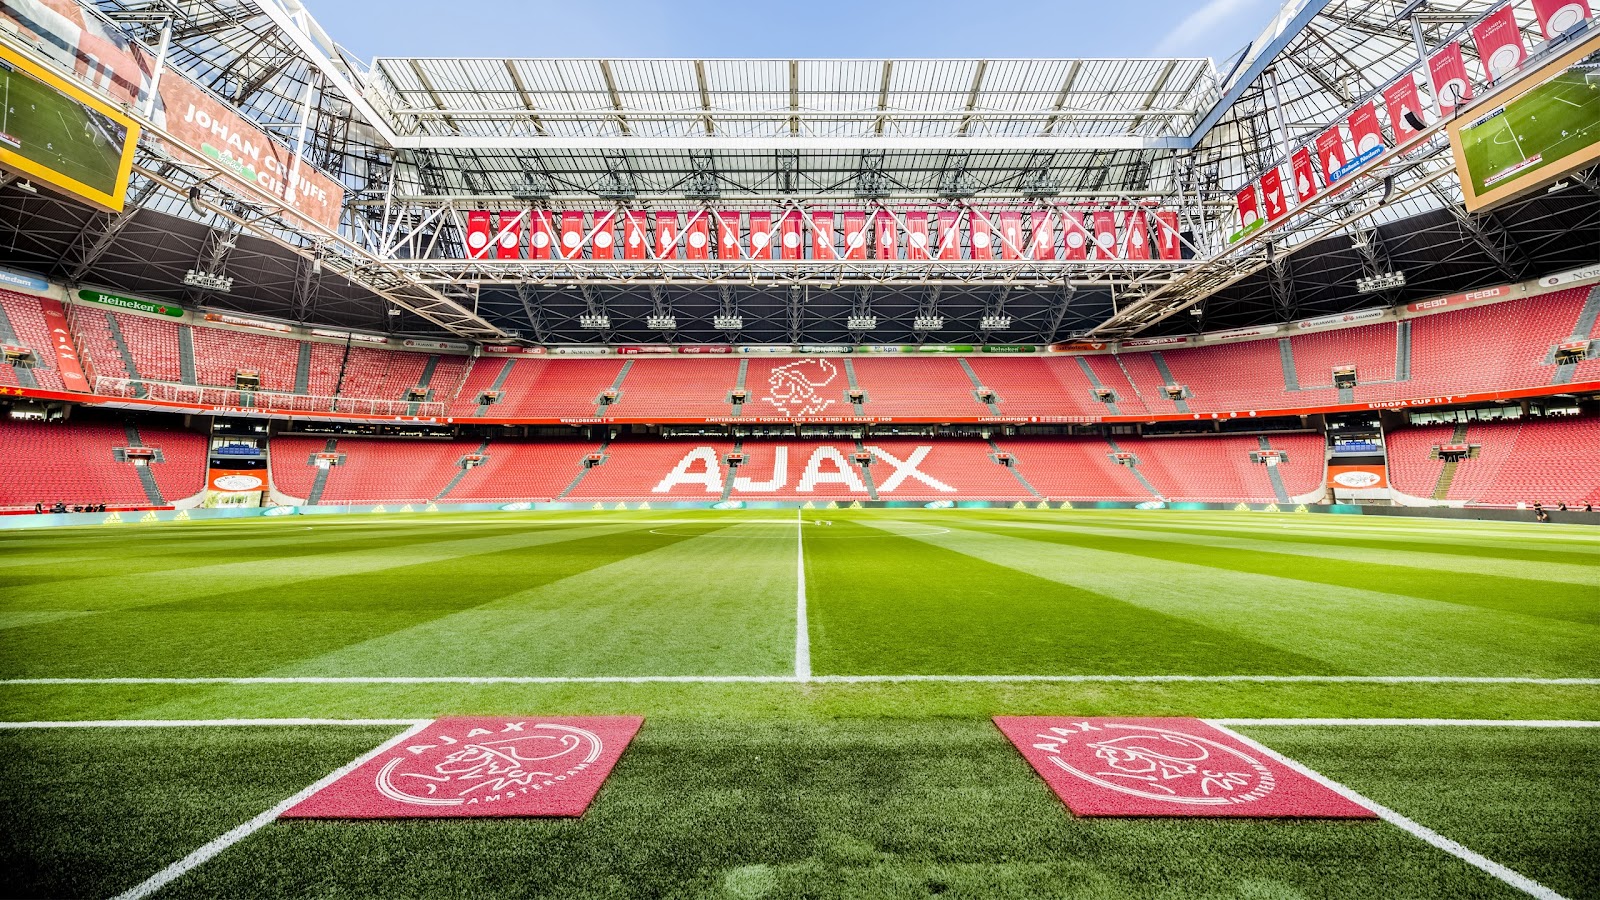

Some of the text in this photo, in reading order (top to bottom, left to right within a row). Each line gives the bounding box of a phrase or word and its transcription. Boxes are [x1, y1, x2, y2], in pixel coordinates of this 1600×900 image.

[184, 103, 260, 160] JOHAN
[98, 294, 155, 312] Heineken
[1415, 288, 1500, 310] FEBO FEBO
[1368, 401, 1408, 409] EUROPA
[652, 446, 958, 493] AJAX
[405, 721, 527, 755] AJAX
[1032, 721, 1103, 754] AJAX
[467, 763, 590, 805] AMSTERDAM
